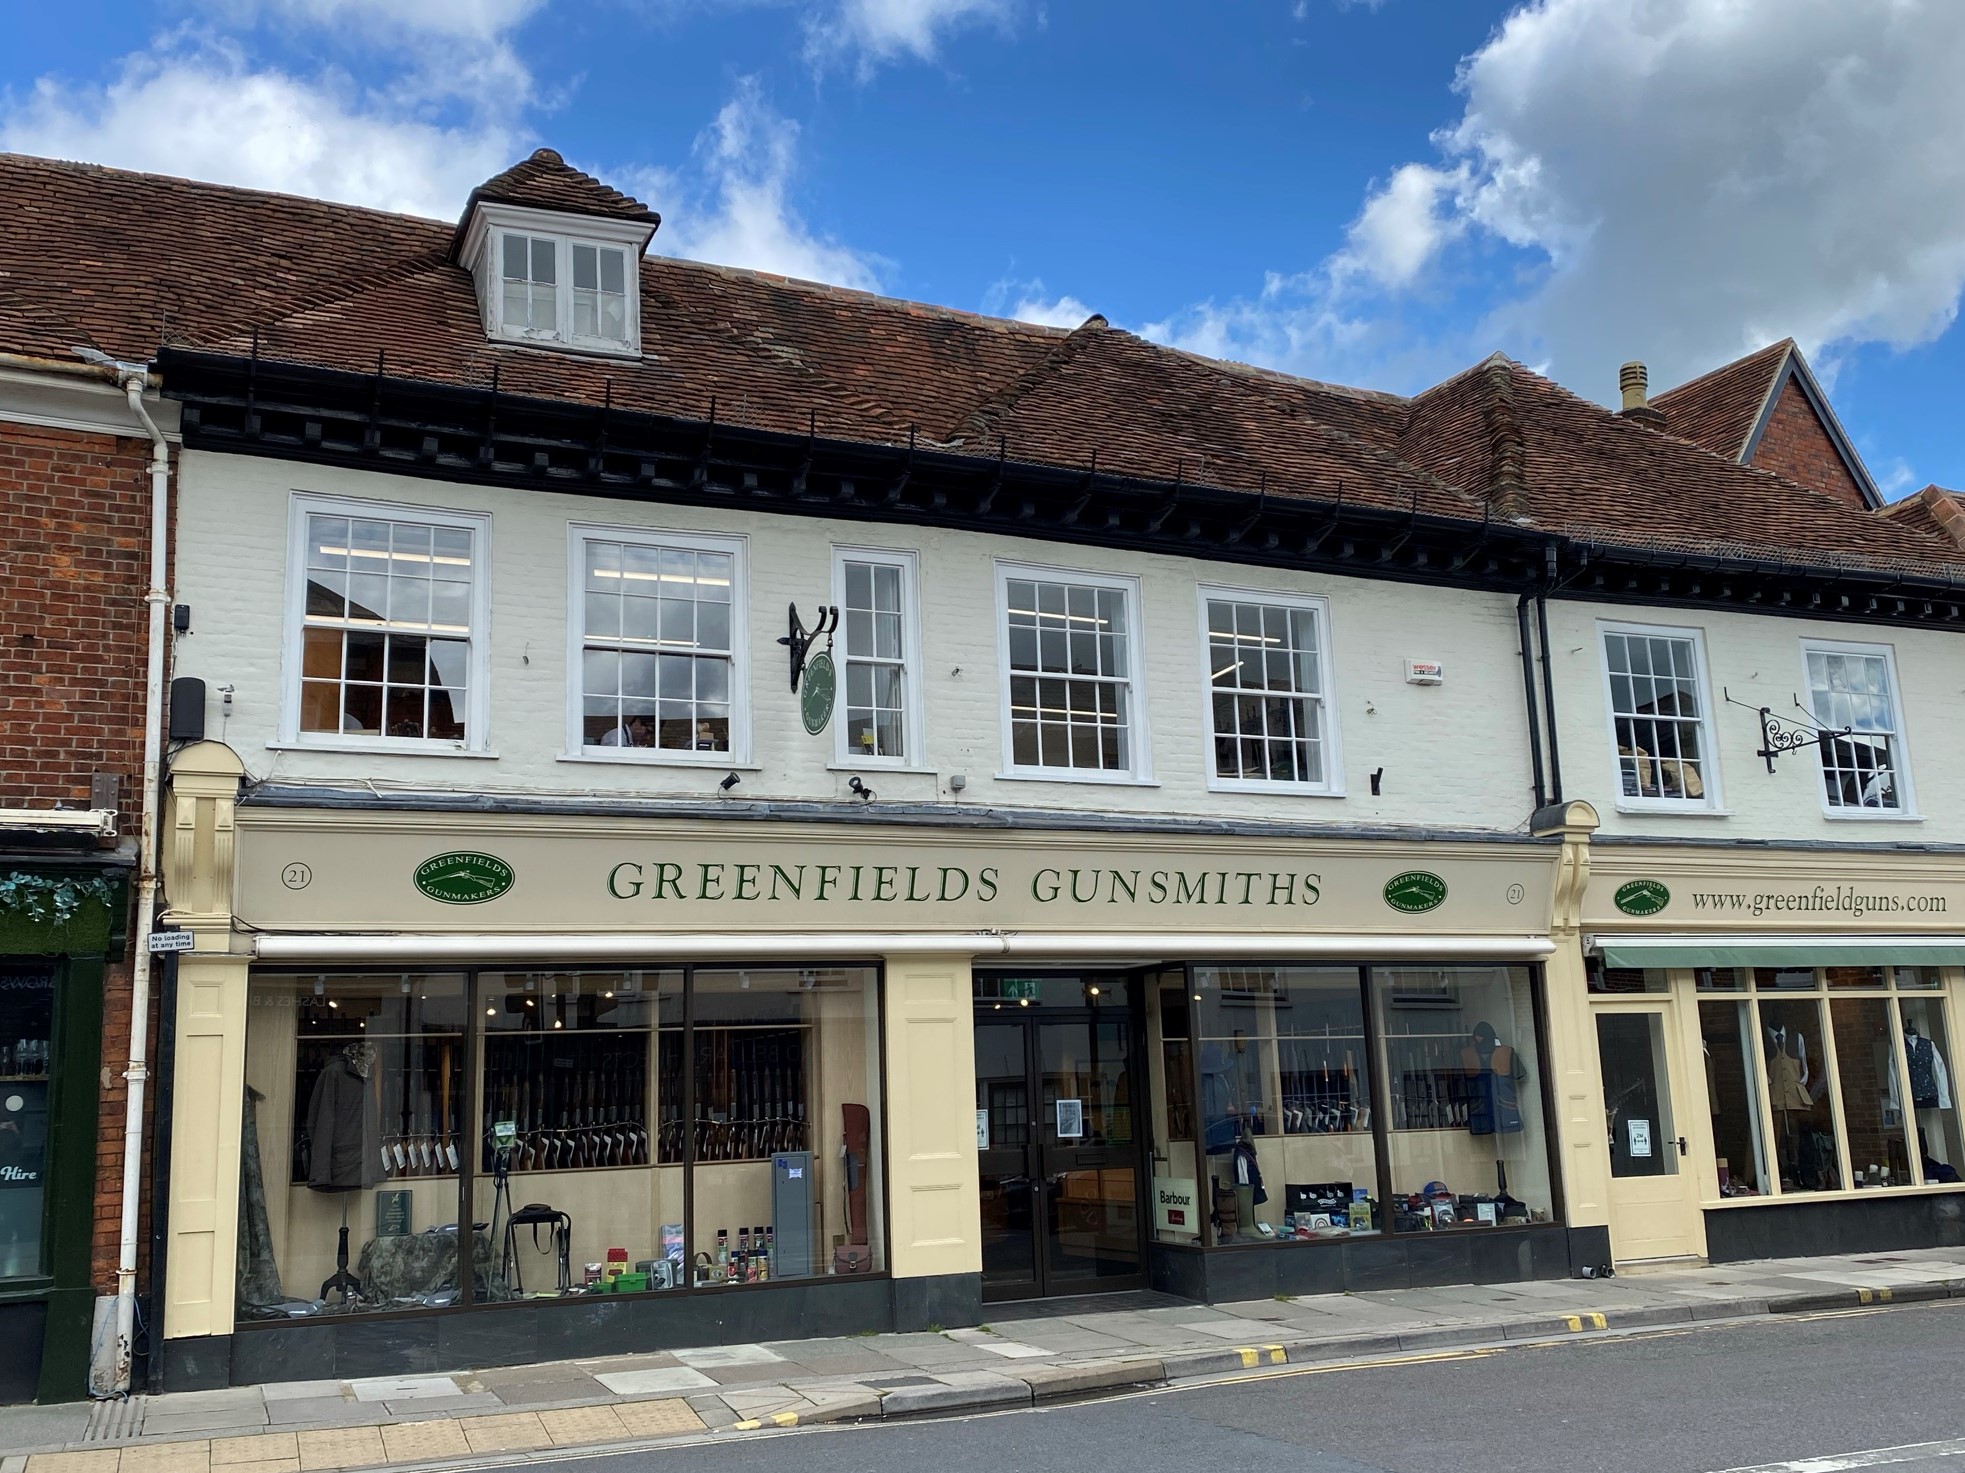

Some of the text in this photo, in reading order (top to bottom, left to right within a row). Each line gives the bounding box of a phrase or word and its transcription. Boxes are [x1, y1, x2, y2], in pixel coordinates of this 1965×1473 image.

[421, 856, 508, 877] GREENFIELDS
[288, 869, 305, 883] 21
[606, 862, 1321, 905] GREENFIELDS GUNSMITHS
[1388, 874, 1444, 892] GREENFIELDS
[426, 885, 501, 900] GUNMAKERS
[1622, 881, 1664, 892] GREENFIELDS
[1510, 889, 1521, 900] 21
[1692, 886, 1947, 917] www.greenfieldguns.com
[1390, 898, 1439, 910] GUNMAKERS
[1622, 905, 1661, 915] GUNMAKERS
[0, 1165, 37, 1181] Hire
[1160, 1190, 1191, 1206] Barbour
